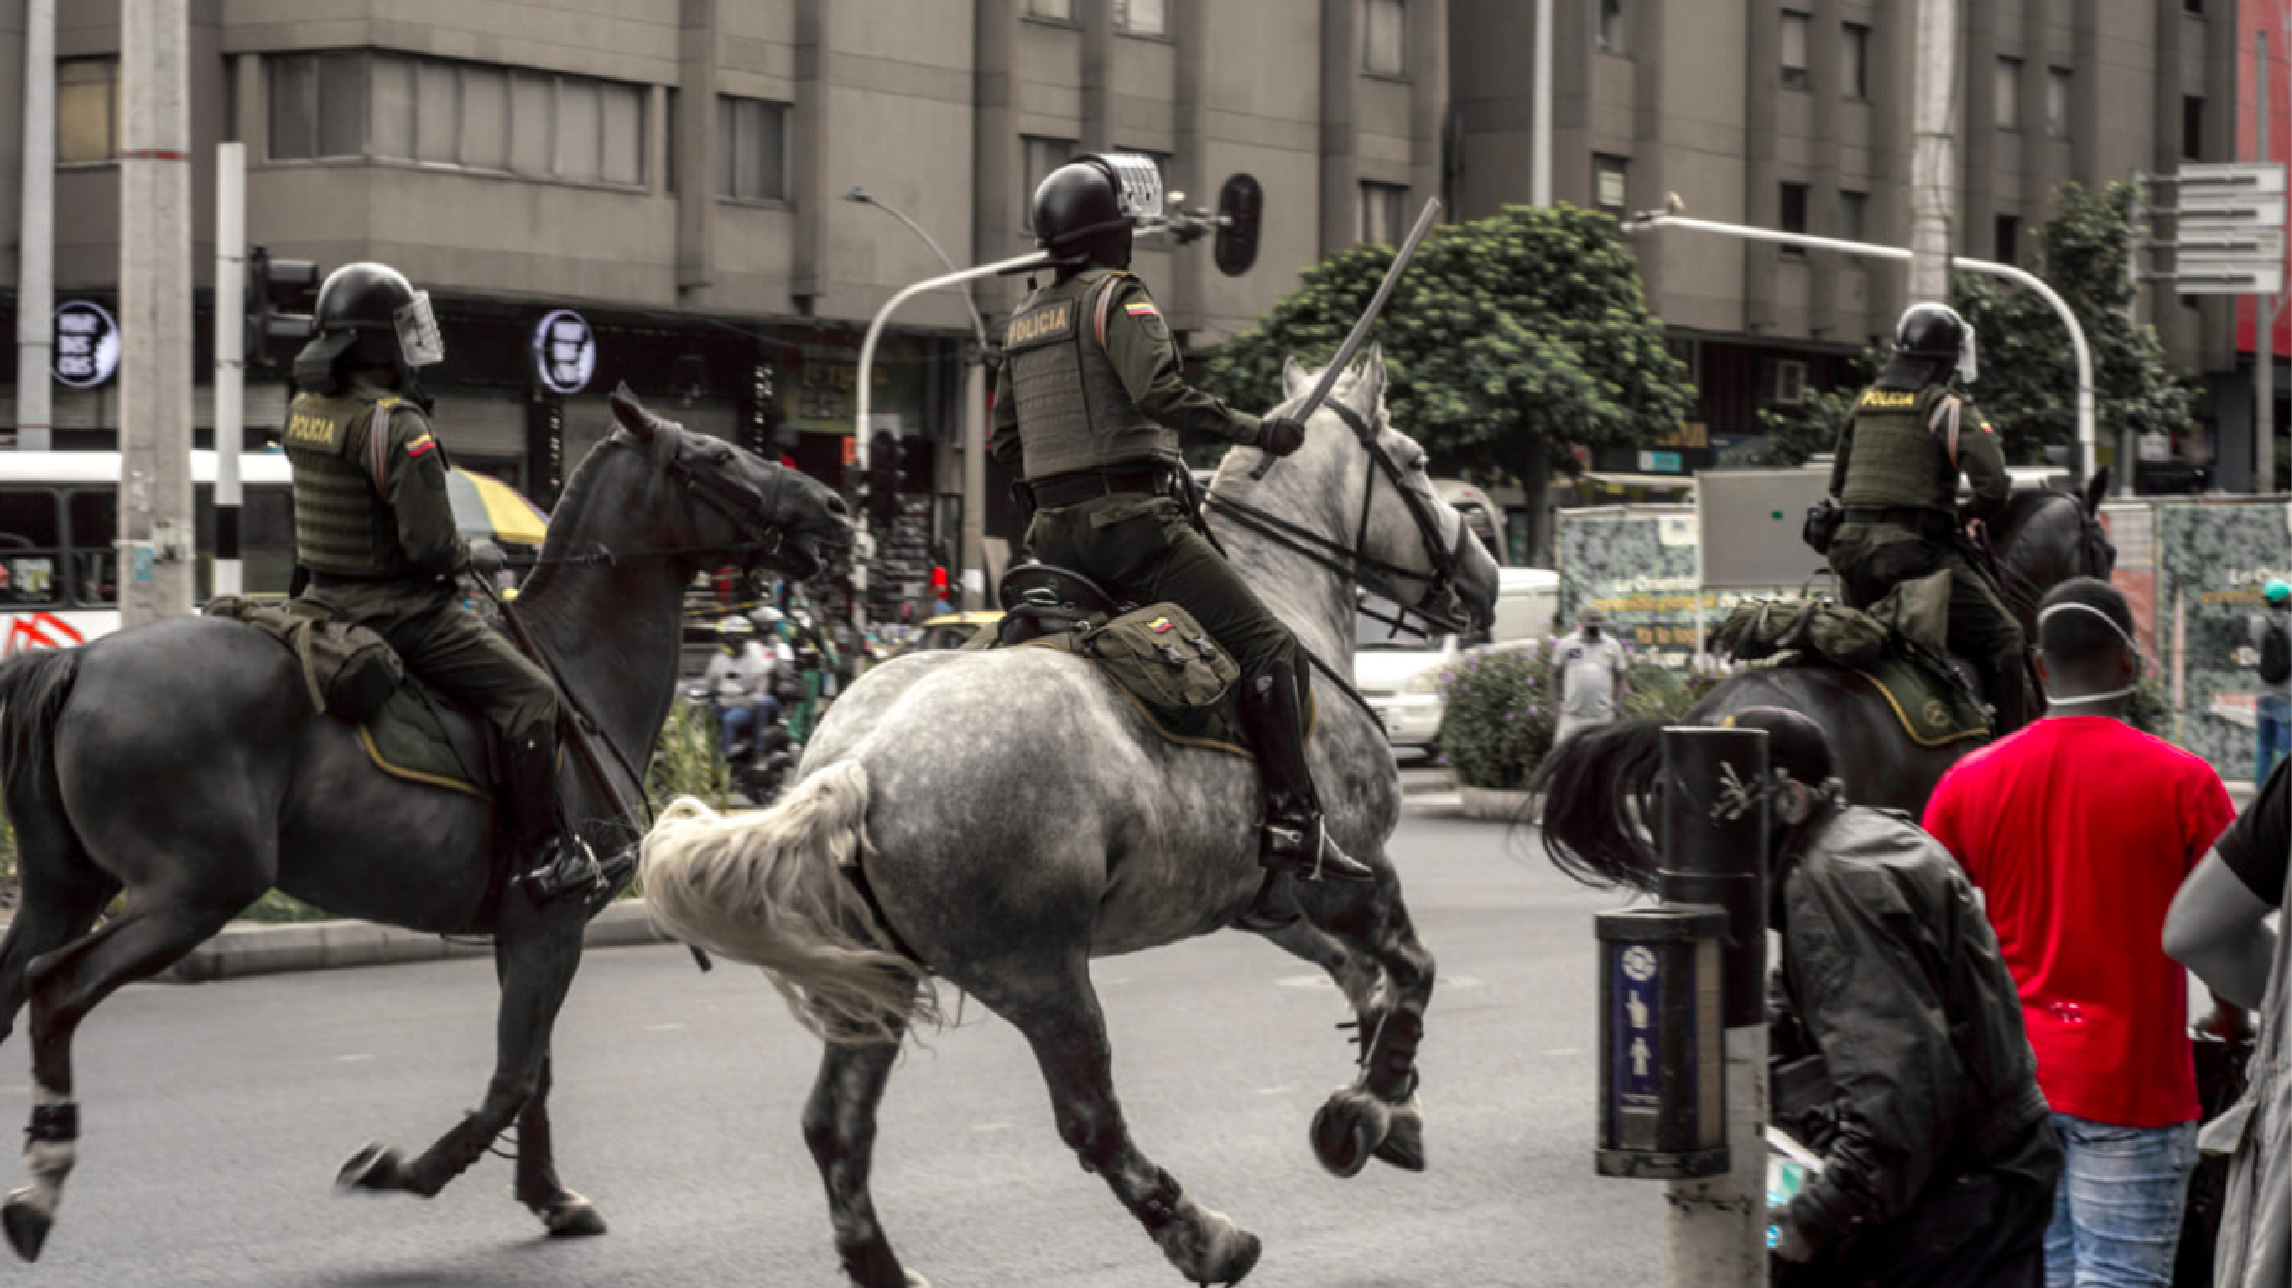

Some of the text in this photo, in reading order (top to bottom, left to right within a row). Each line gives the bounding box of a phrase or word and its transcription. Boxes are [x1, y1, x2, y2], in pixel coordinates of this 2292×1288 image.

[1006, 306, 1066, 348] POLICIA
[1861, 387, 1915, 406] POLICIA
[288, 413, 335, 444] POLICIA
